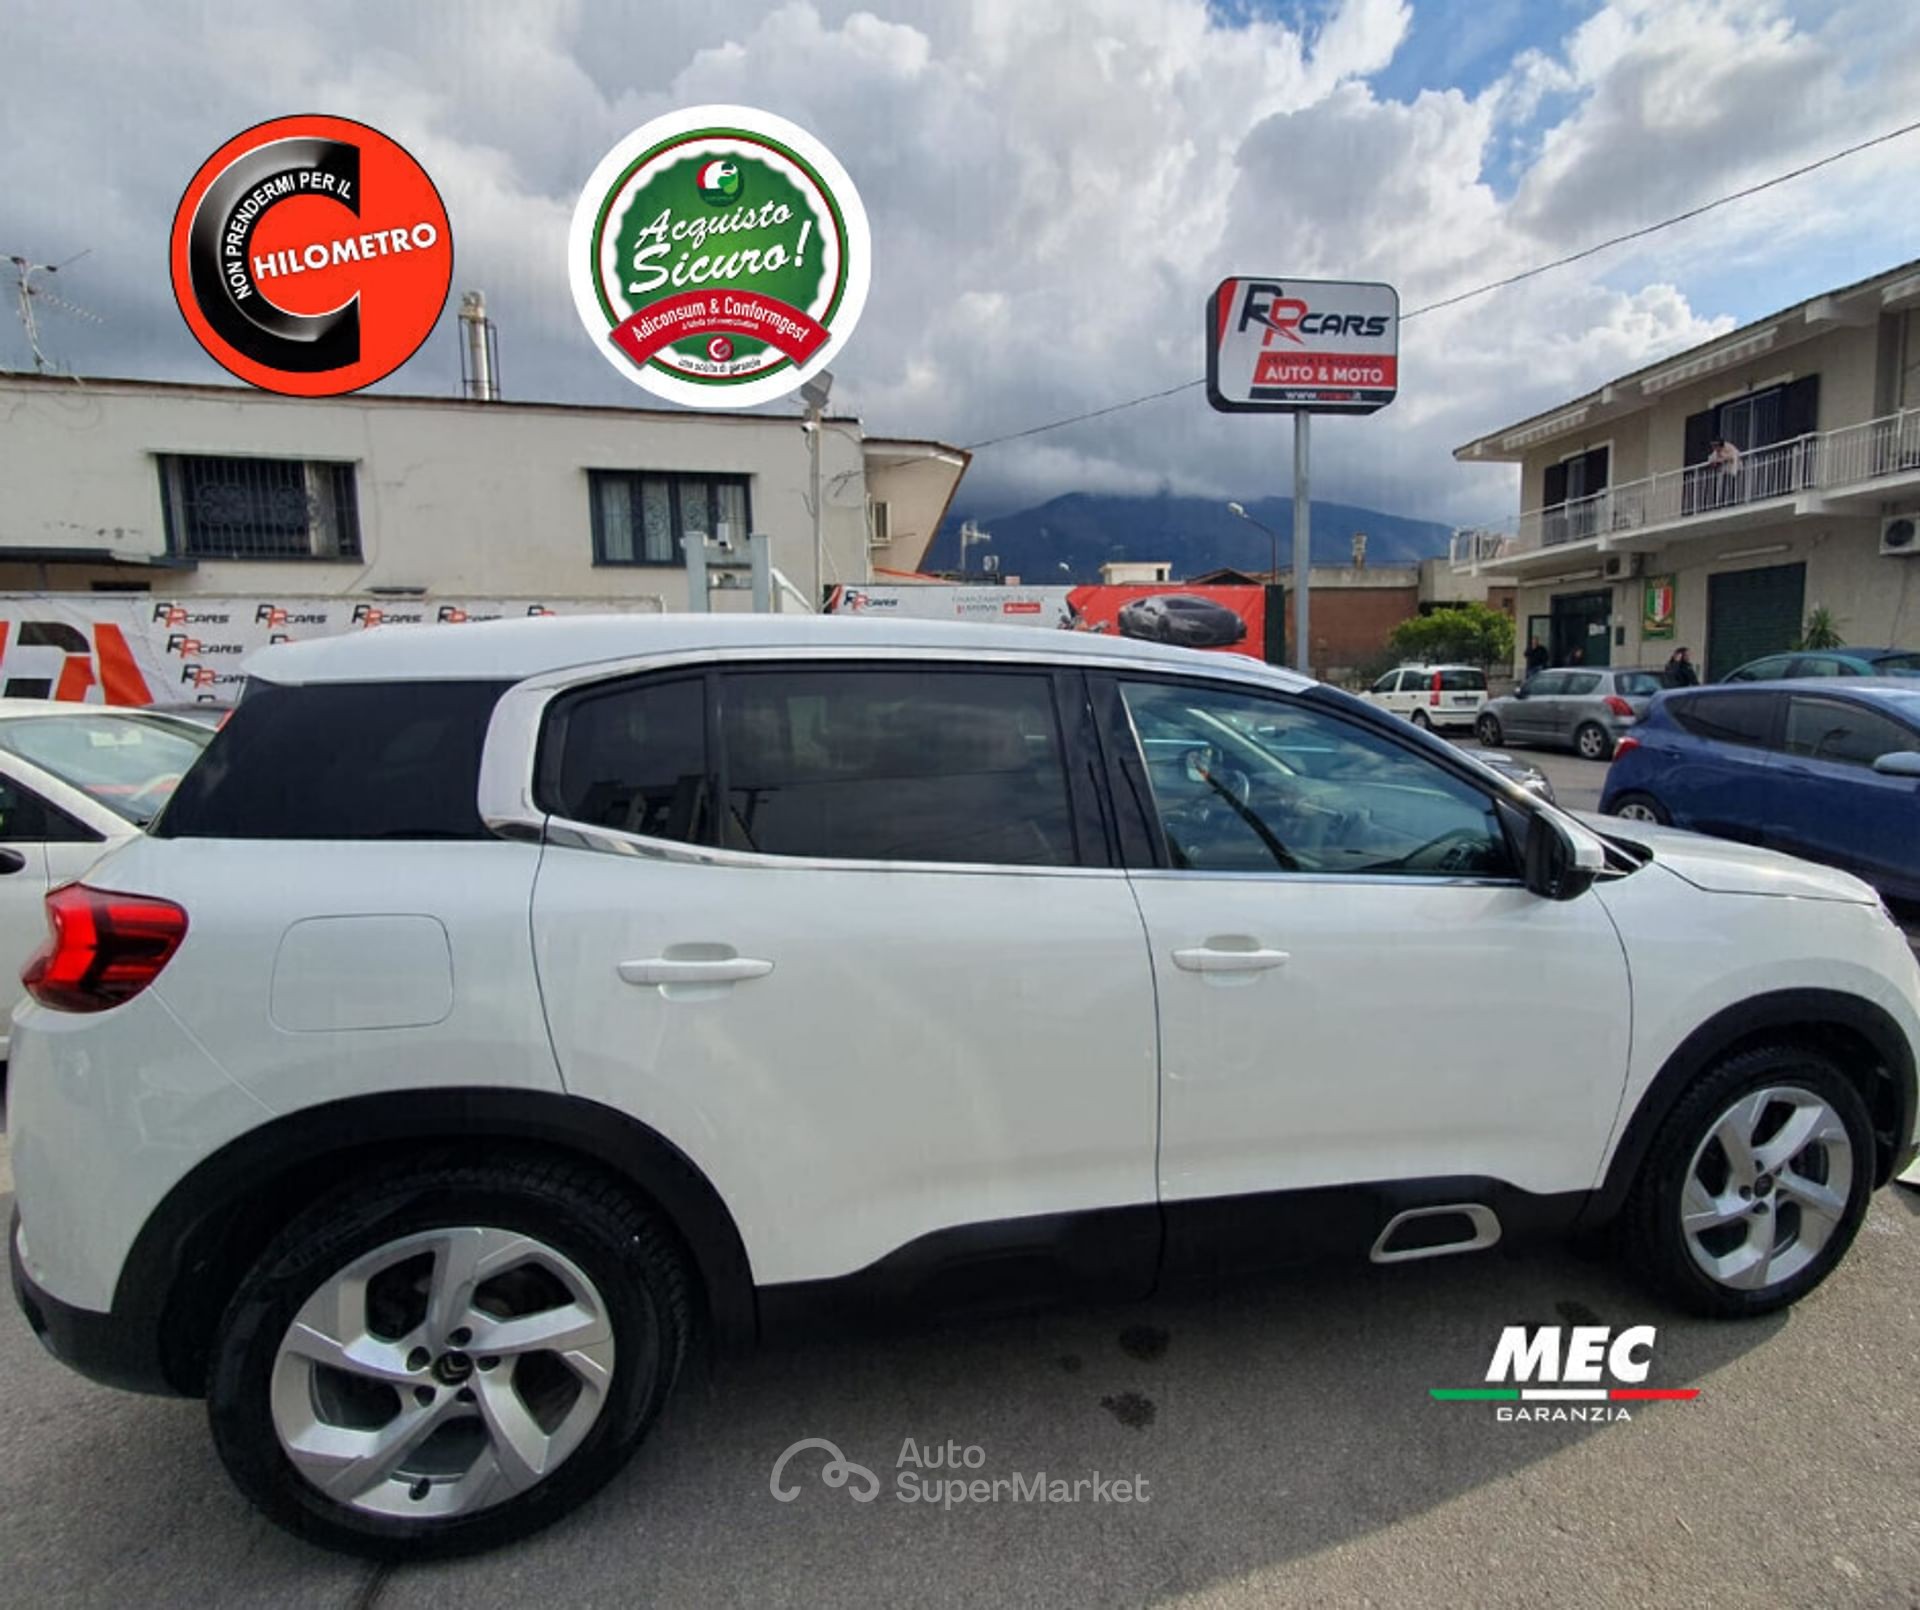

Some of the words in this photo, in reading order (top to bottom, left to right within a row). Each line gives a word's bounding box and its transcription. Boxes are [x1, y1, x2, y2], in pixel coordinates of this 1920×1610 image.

[1265, 365, 1313, 381] AUTO
[1318, 367, 1329, 381] &
[1333, 367, 1383, 384] MOTO
